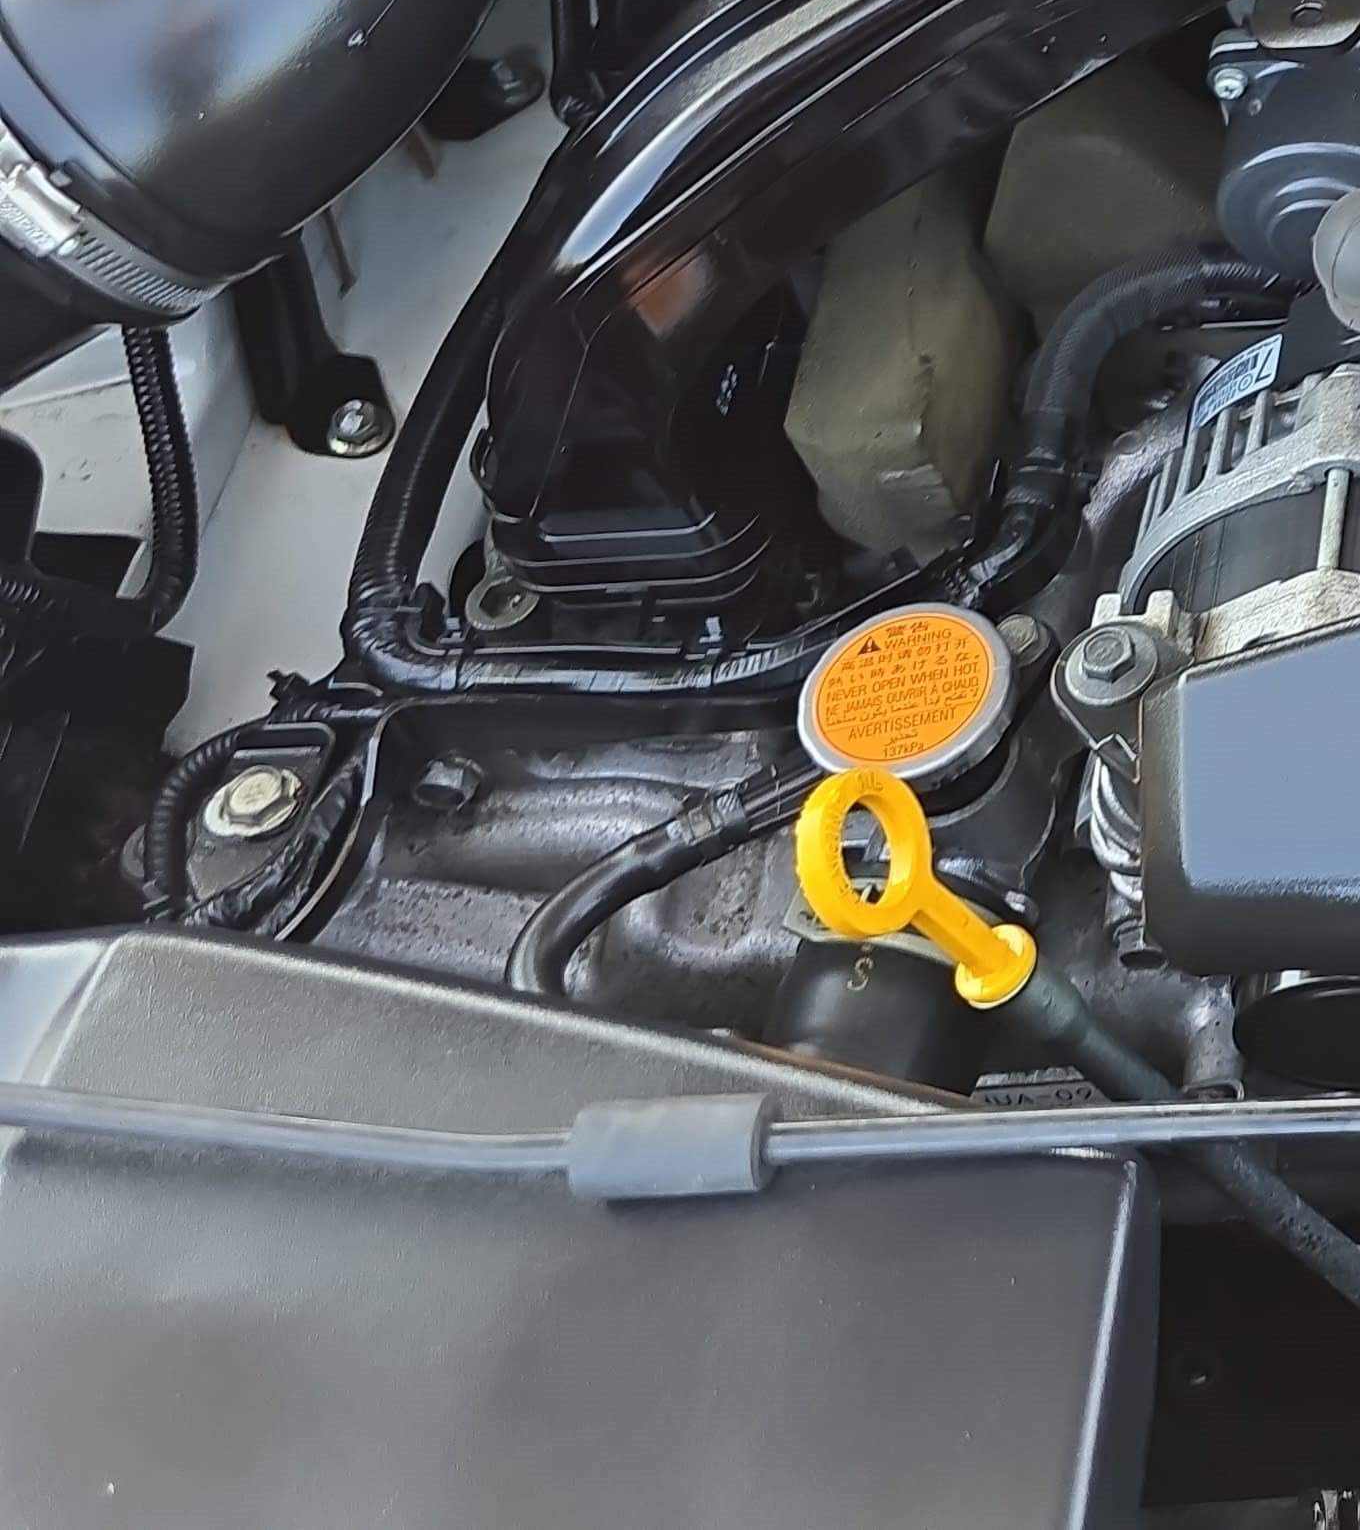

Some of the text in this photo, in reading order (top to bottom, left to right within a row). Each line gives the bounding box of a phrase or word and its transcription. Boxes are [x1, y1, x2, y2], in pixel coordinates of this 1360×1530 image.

[884, 628, 952, 650] WARNING
[825, 705, 841, 718] NE
[843, 694, 883, 715] JAMAIS
[886, 685, 927, 704] OUVRIR
[826, 684, 867, 703] NEVER
[872, 674, 906, 693] OPEN
[911, 668, 950, 686] WHEN
[848, 707, 957, 741] AVERTISSEMENT
[882, 742, 925, 758] 137kPa
